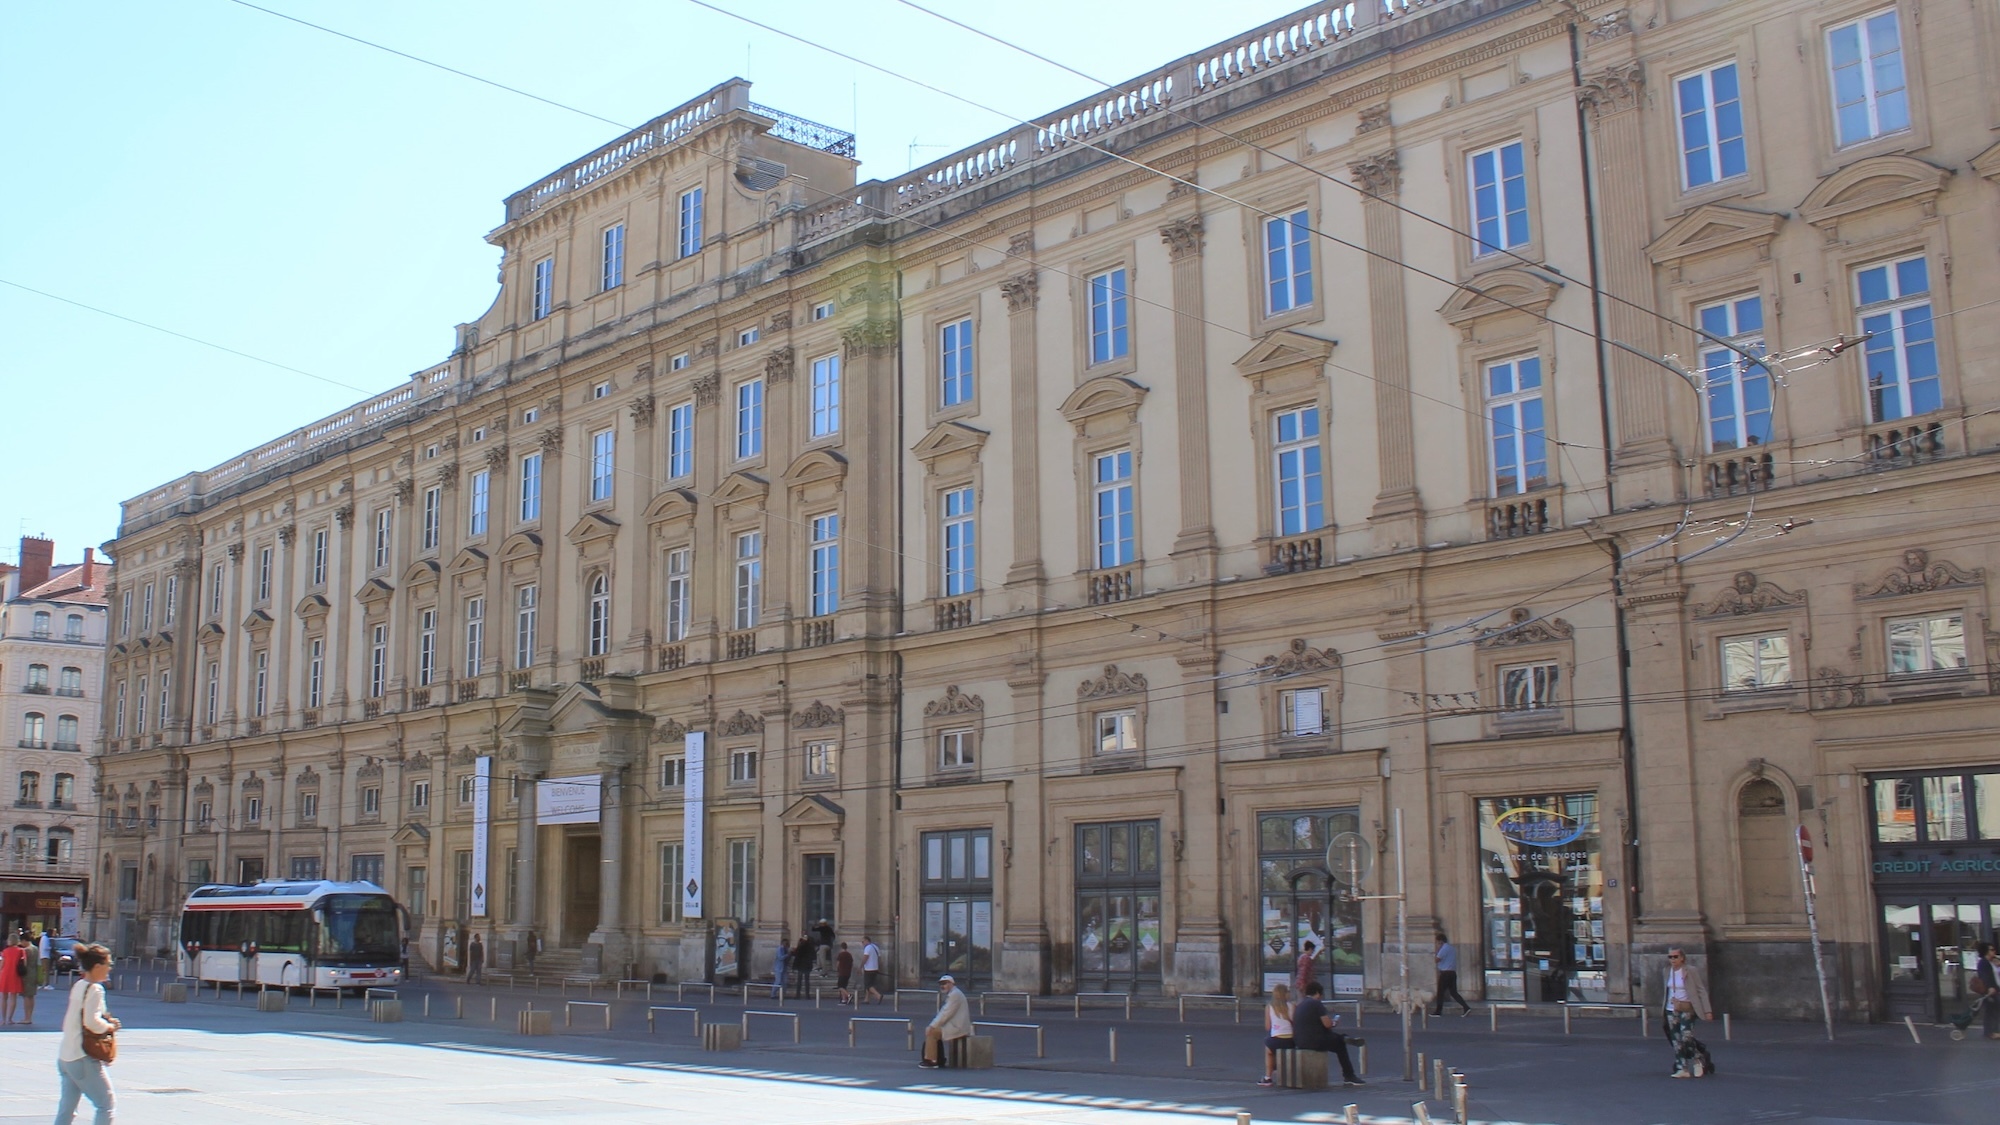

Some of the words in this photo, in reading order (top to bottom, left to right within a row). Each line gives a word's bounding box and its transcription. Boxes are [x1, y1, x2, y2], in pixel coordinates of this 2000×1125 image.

[551, 786, 585, 797] BIENVENUE
[551, 804, 585, 815] WELCOME
[1531, 852, 1542, 860] de
[1546, 851, 1587, 862] Voyages
